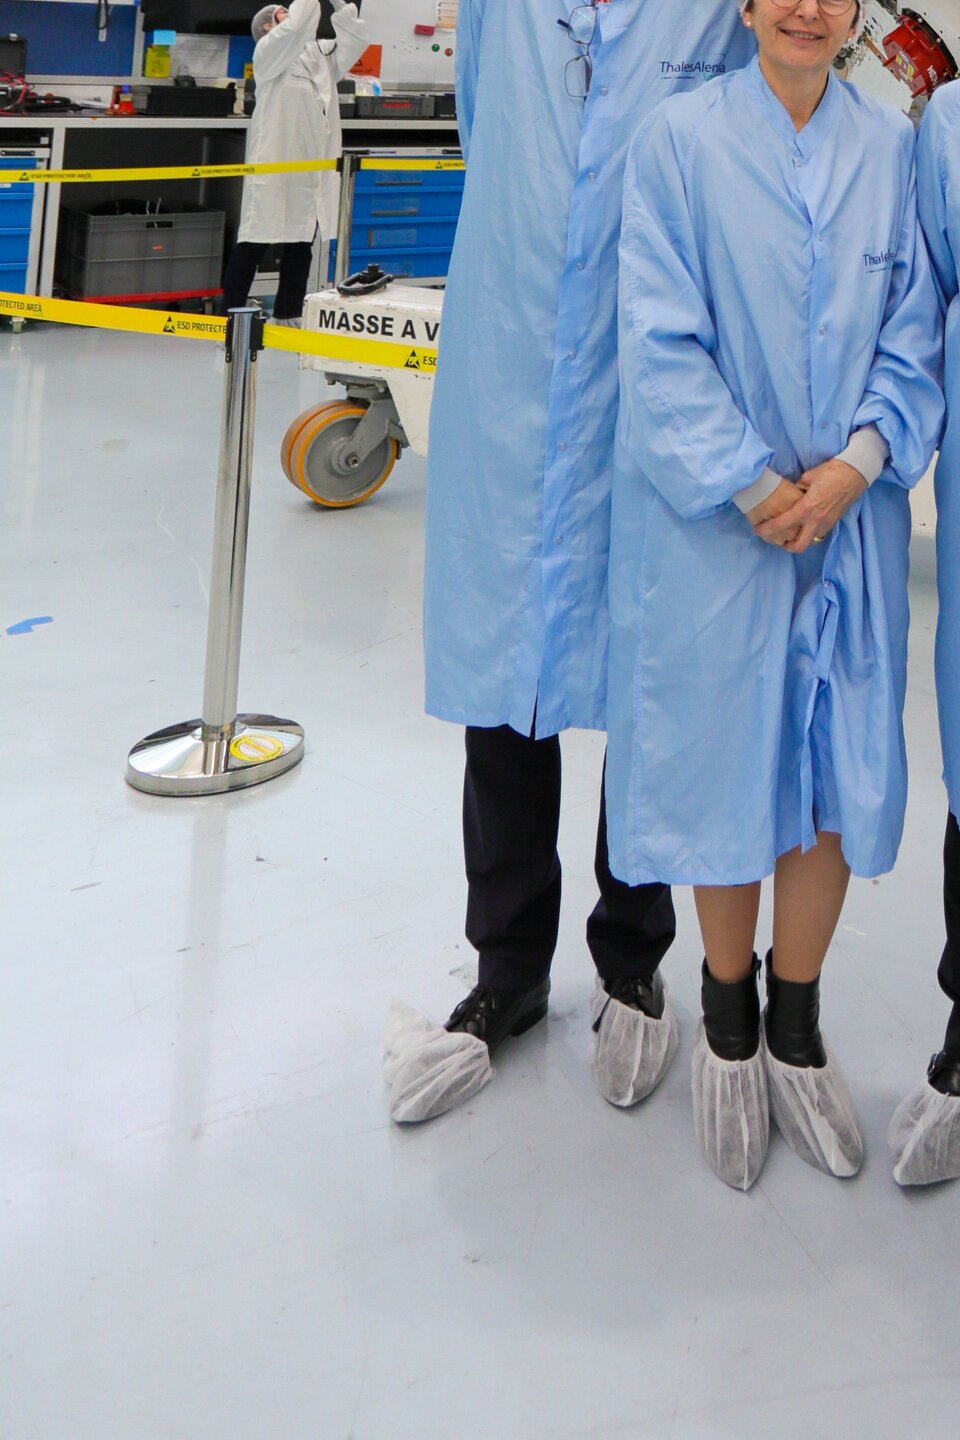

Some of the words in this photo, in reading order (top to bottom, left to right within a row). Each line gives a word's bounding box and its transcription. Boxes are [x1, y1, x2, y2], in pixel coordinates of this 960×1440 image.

[26, 303, 42, 312] AREA
[177, 321, 191, 330] ESD
[319, 309, 394, 337] MASSE
[401, 320, 417, 339] A
[424, 321, 440, 342] V
